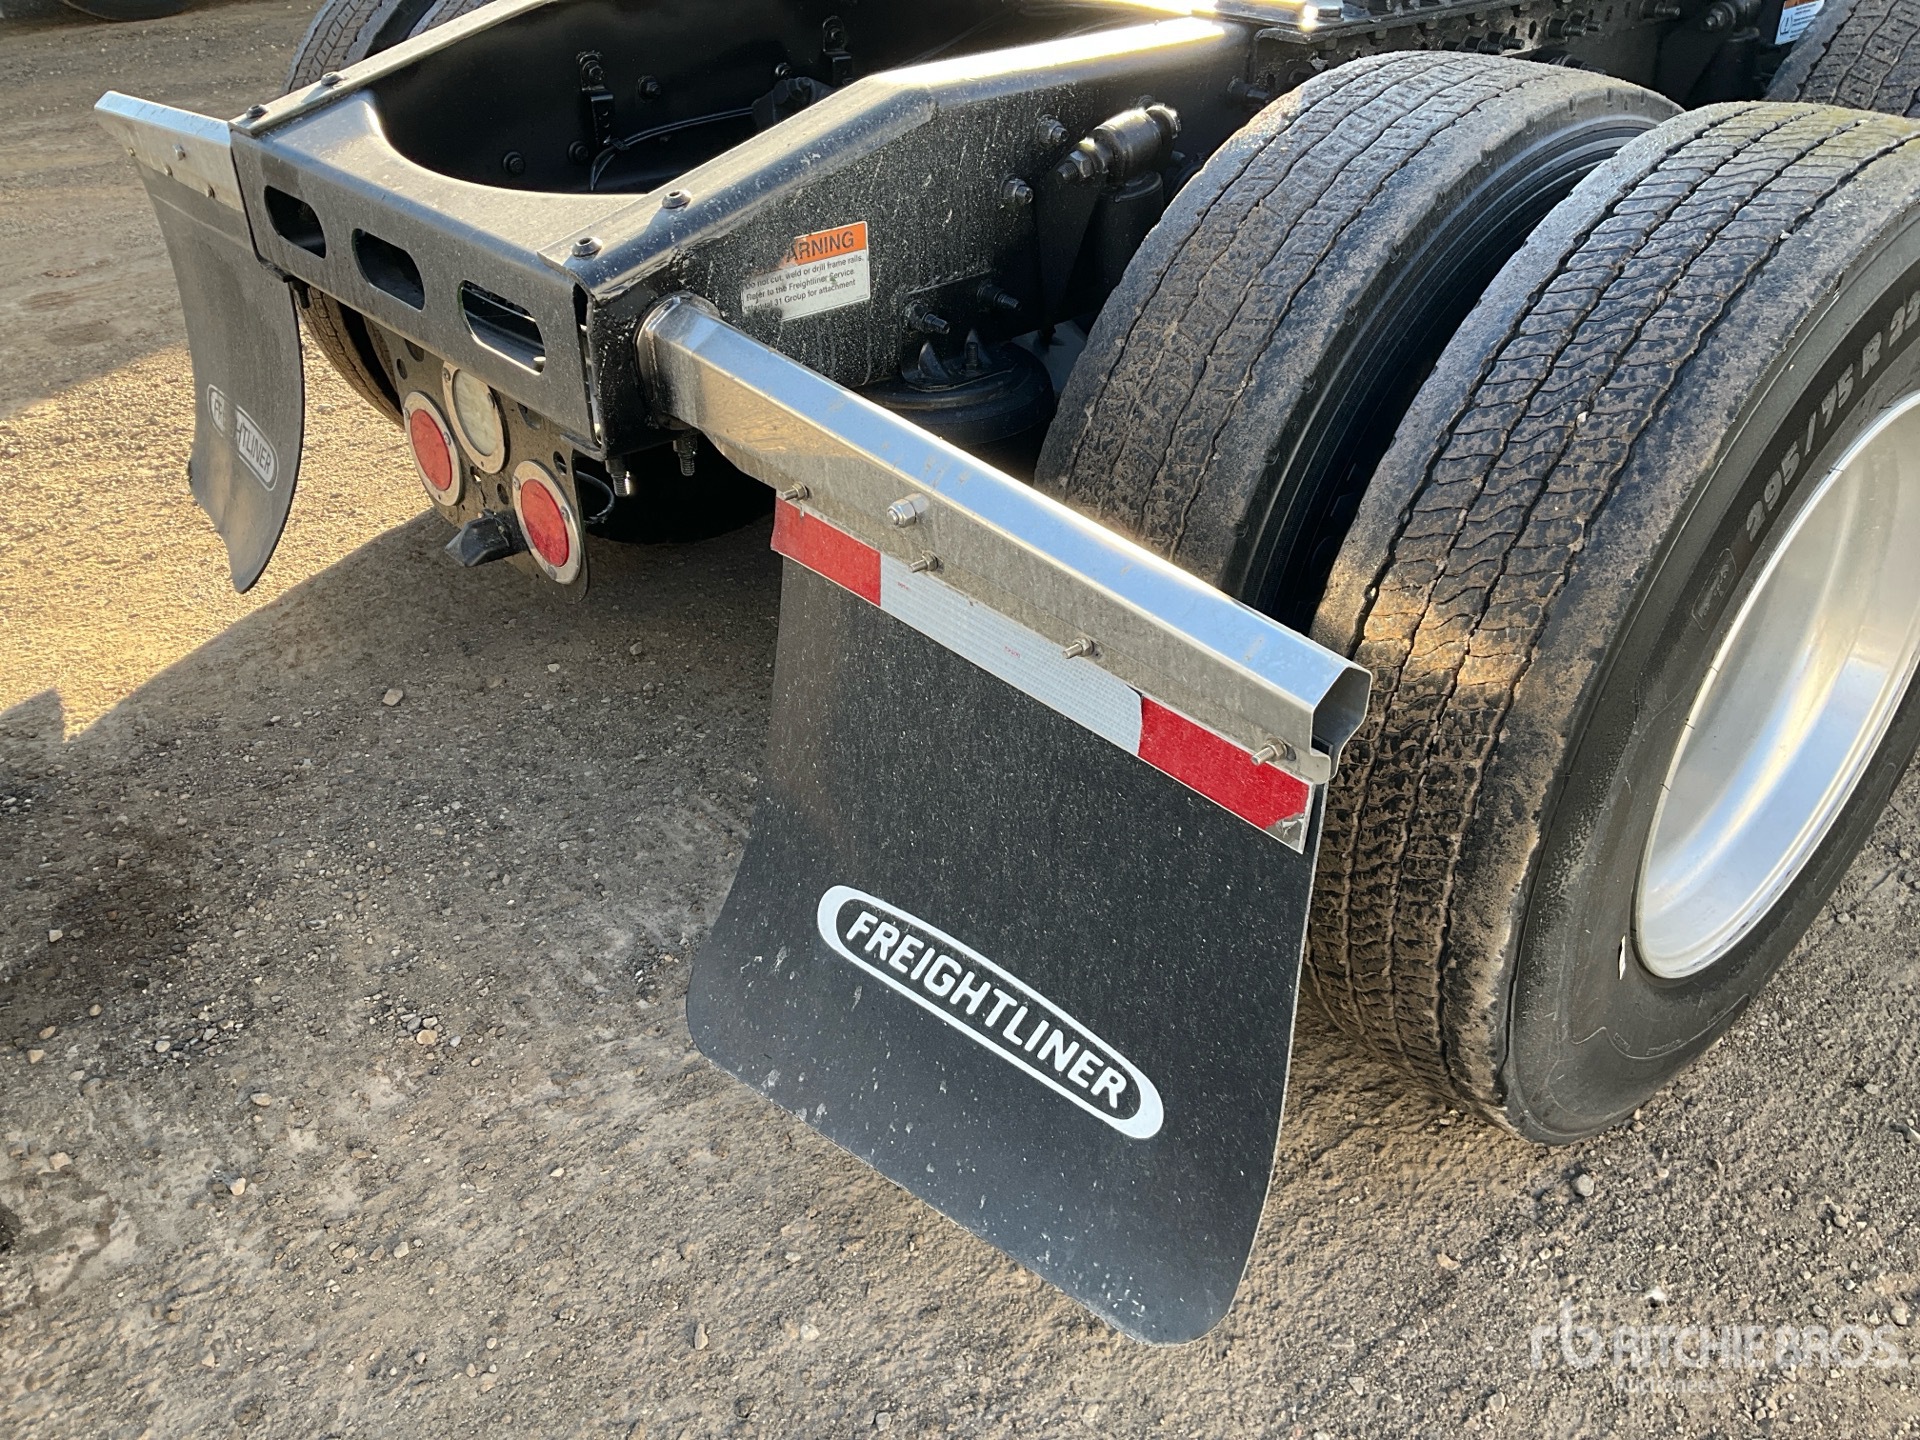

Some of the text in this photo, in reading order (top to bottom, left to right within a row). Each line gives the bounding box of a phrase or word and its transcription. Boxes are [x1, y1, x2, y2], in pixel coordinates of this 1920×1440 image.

[786, 231, 854, 262] ARNING
[757, 278, 770, 287] not
[785, 269, 802, 280] weld
[803, 267, 811, 276] or
[812, 262, 826, 274] drill
[827, 259, 847, 270] frame
[746, 291, 765, 302] Refer
[767, 288, 775, 296] to
[775, 284, 788, 294] the
[788, 274, 829, 291] Freightliner
[774, 297, 783, 307] 31
[784, 290, 807, 303] Group
[807, 288, 818, 298] for
[818, 278, 857, 295] attachment
[846, 910, 1128, 1109] FREIGHTLINER
